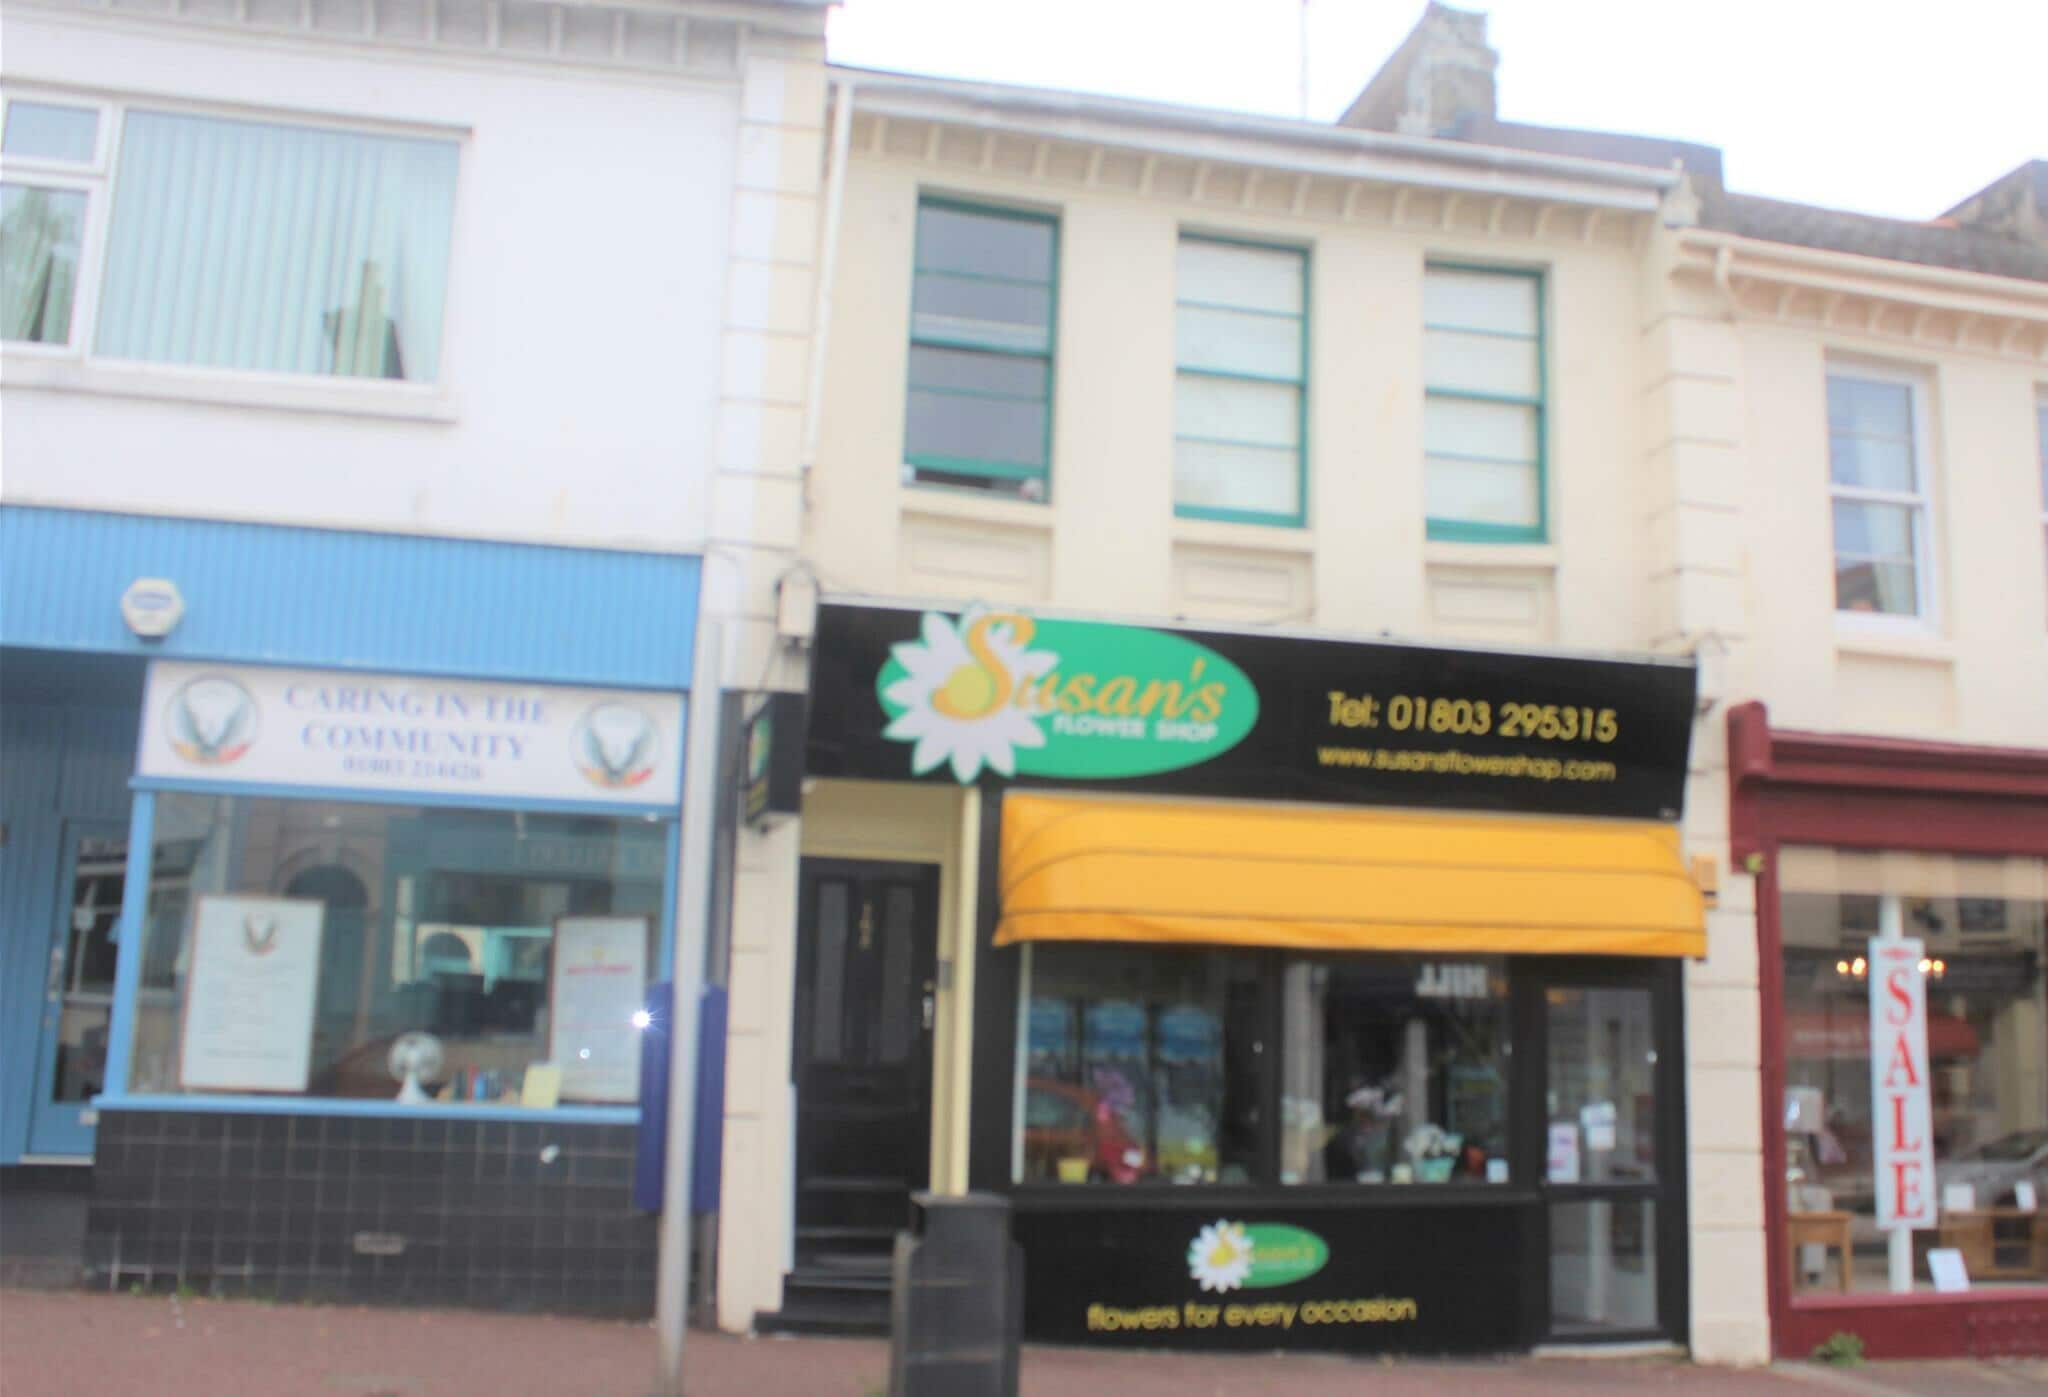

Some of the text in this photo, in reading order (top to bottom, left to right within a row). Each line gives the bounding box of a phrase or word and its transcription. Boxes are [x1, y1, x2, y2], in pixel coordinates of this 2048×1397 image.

[930, 611, 1226, 723] Susan's
[283, 683, 548, 724] CARING IN THE
[1327, 690, 1619, 743] Tel: 01803 295315
[301, 721, 528, 760] COMMUNITY
[1052, 713, 1219, 743] FLOWER SHOP
[1883, 967, 1926, 1221] SALE
[1087, 1298, 1418, 1331] flowers for every occasion
